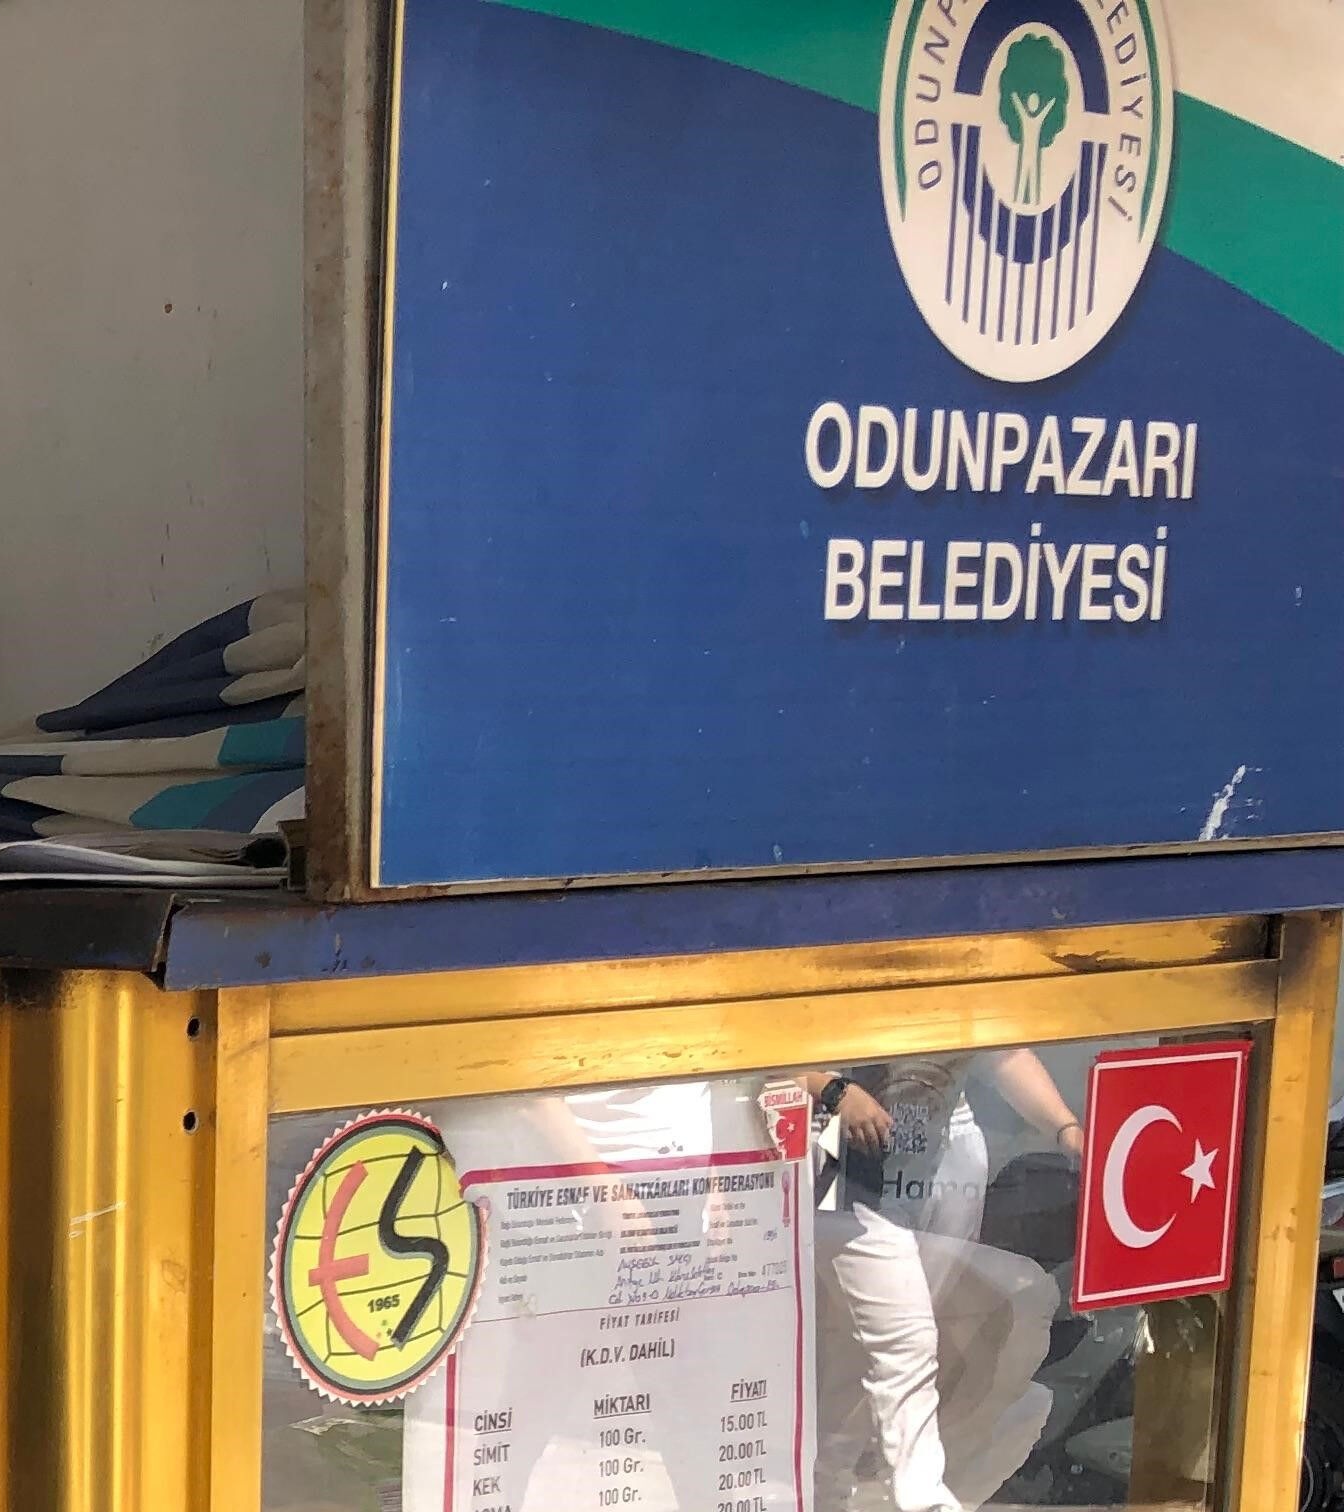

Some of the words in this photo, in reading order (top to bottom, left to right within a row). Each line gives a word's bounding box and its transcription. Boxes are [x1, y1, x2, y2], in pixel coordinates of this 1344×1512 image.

[805, 401, 1199, 499] ODUNPAZARI
[824, 523, 1168, 623] BELEDİYESİ
[507, 1186, 553, 1210] TÜRKİYE
[593, 1185, 608, 1203] VE
[367, 1293, 401, 1314] 1965
[600, 1313, 630, 1330] FİYAT
[635, 1307, 680, 1327] TARİFESİ
[580, 1345, 625, 1368] (K.D.V.
[629, 1337, 675, 1361] DAHİL)
[474, 1407, 513, 1432] CİNSİ
[594, 1393, 651, 1416] MİKTARI
[730, 1378, 767, 1400] FİYATI
[473, 1441, 511, 1466] SİMİT
[600, 1429, 620, 1448] 100
[624, 1428, 646, 1445] Gr.
[720, 1413, 755, 1433] 15.00
[757, 1411, 768, 1428] TL
[473, 1476, 502, 1496] KEK
[600, 1459, 619, 1477] 100
[623, 1457, 644, 1474] Gr.
[719, 1442, 753, 1462] 20.00
[755, 1439, 767, 1456] TL
[599, 1488, 619, 1507] 100
[622, 1486, 642, 1503] Gr.
[718, 1470, 752, 1491] 20.00
[754, 1468, 766, 1484] TL
[753, 1496, 767, 1512] TL
